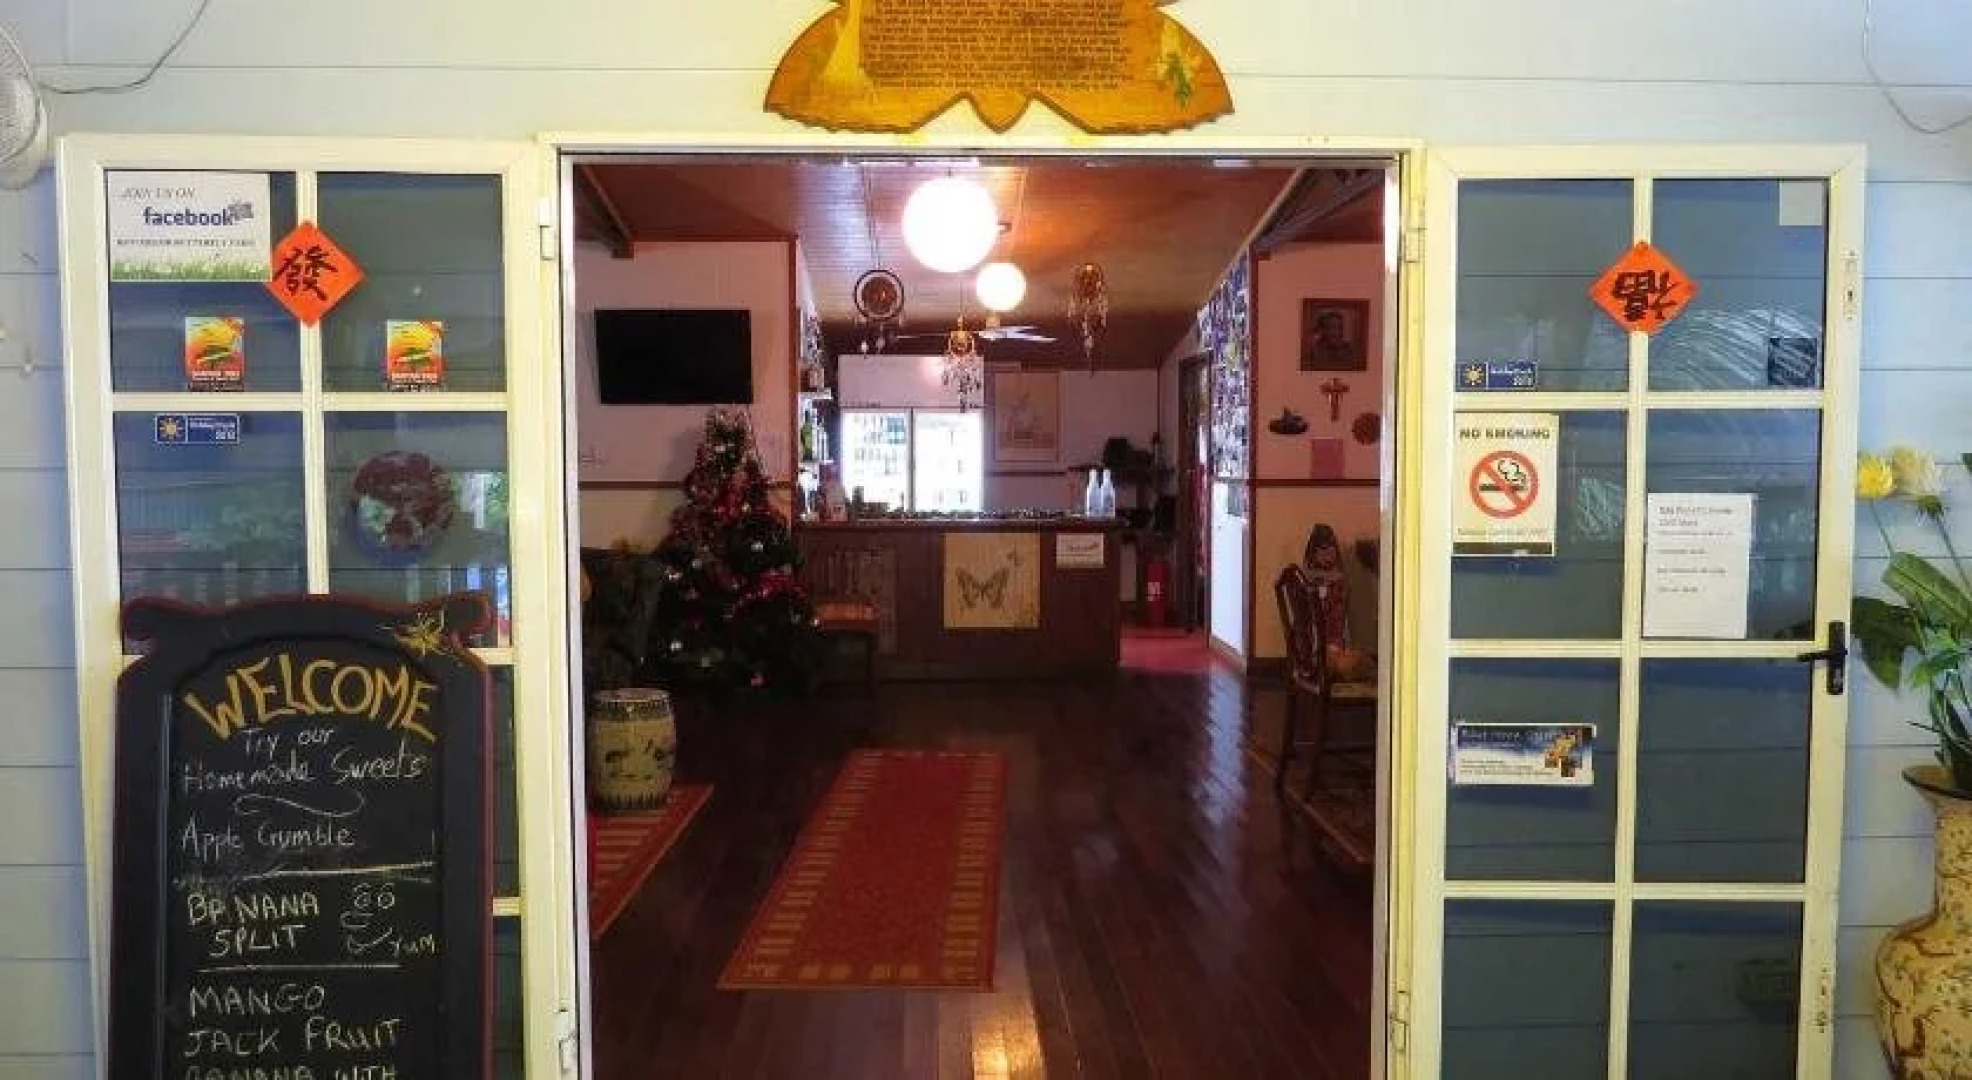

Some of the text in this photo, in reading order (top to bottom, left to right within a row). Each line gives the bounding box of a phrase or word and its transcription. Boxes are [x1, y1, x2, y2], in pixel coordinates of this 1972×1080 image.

[143, 206, 234, 226] facebook
[183, 653, 439, 742] WELCOME
[242, 727, 335, 760] Try our
[330, 737, 428, 786] Sweets
[181, 809, 244, 863] Apple
[187, 890, 320, 926] BANANA
[208, 924, 307, 958] SPLIT
[189, 982, 326, 1019] MANGO
[184, 1016, 402, 1058] JACK FRUIT
